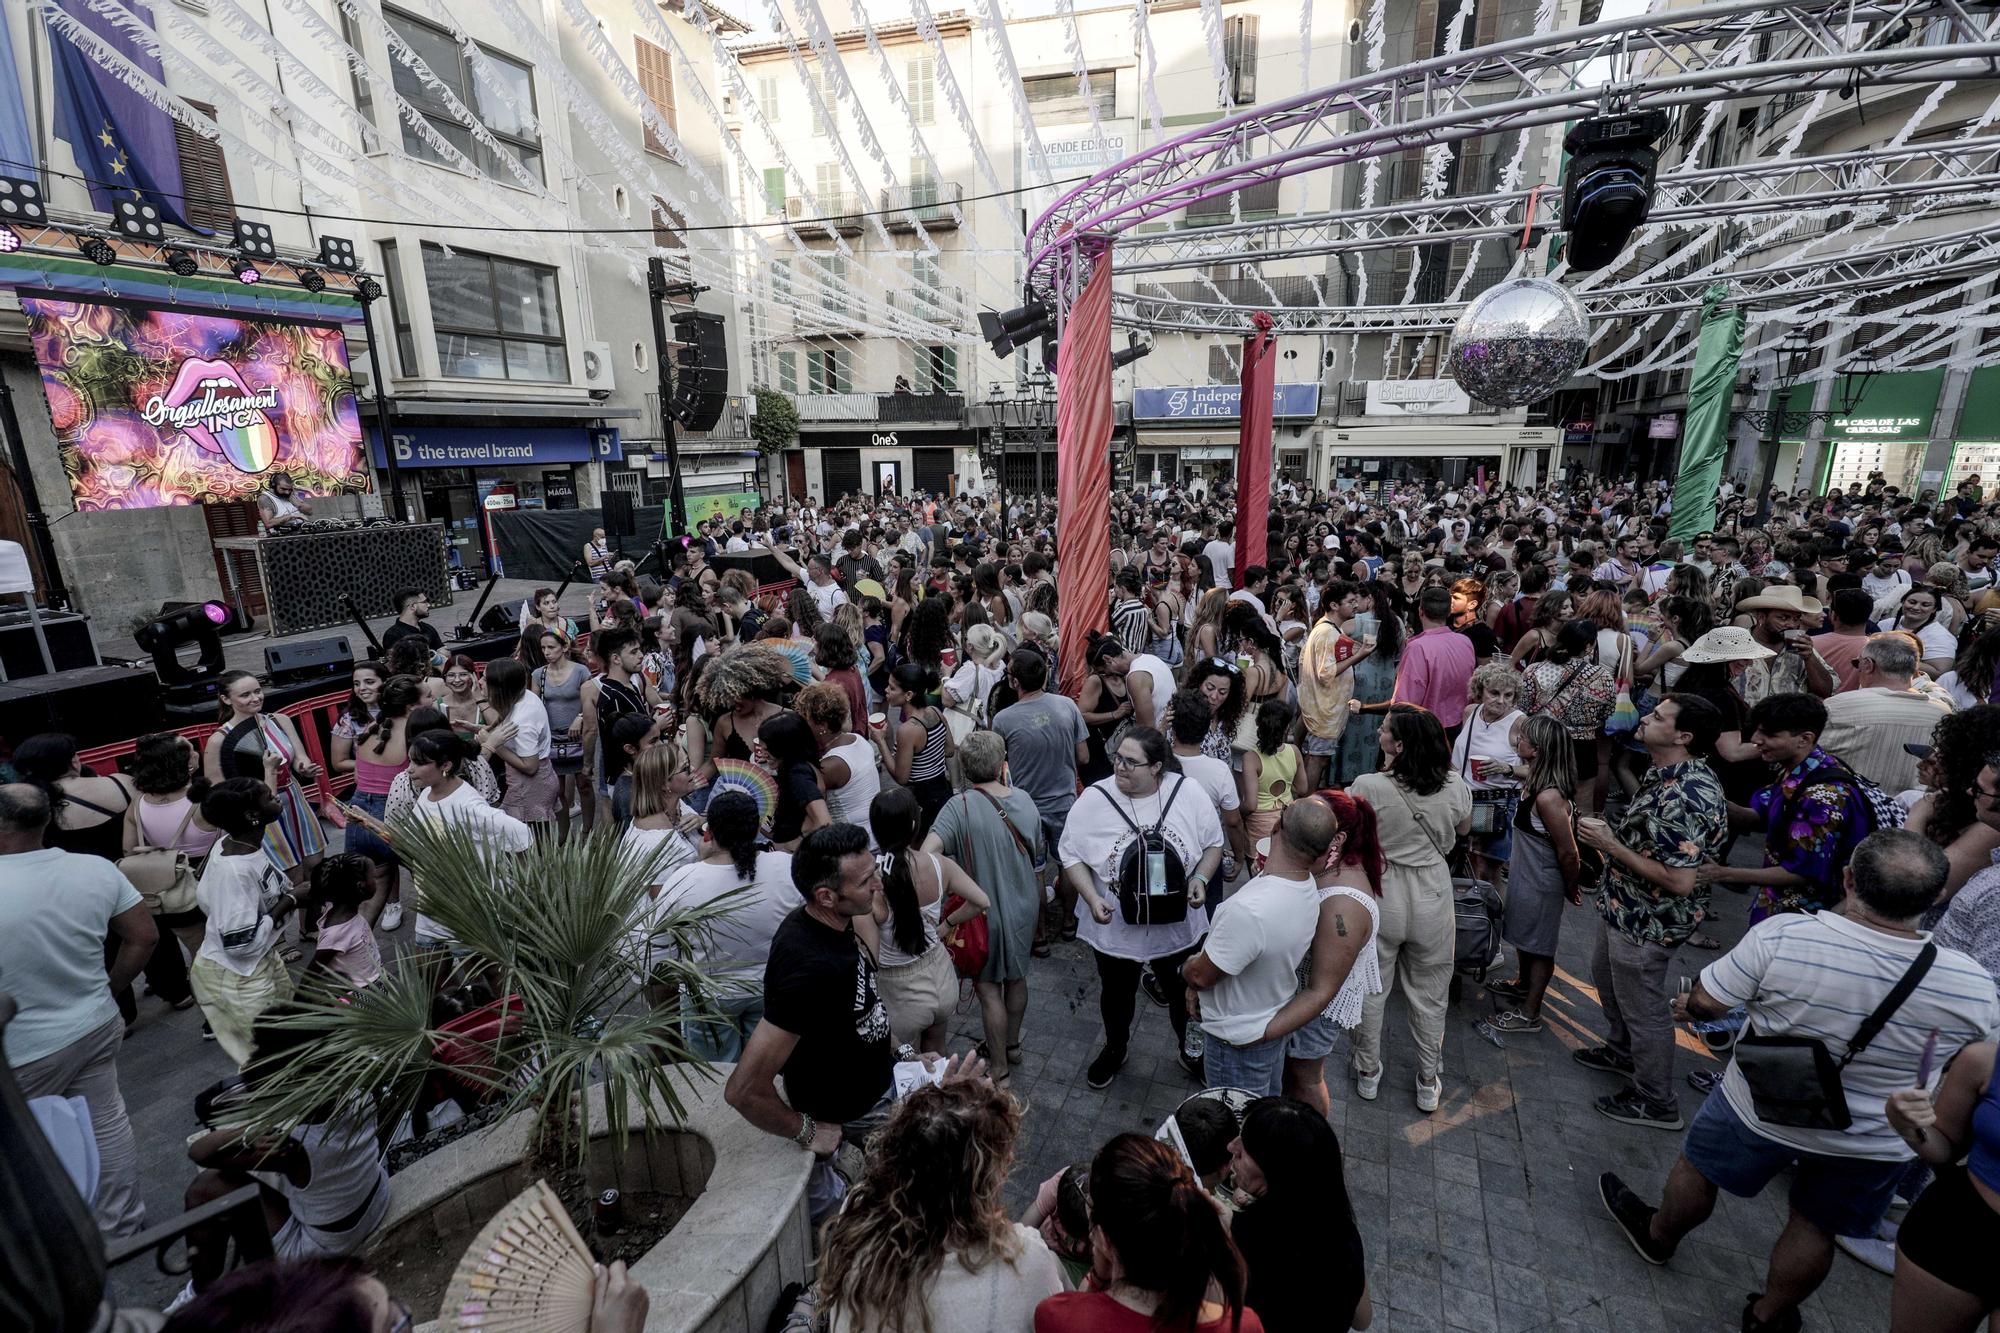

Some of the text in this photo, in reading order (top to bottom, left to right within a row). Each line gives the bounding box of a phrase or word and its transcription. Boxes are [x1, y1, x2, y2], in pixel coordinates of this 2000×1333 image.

[1043, 140, 1079, 154] VENDE
[141, 385, 279, 429] Orgullosament
[1191, 403, 1231, 416] d'Inca
[1405, 402, 1429, 411] NOU
[208, 408, 265, 434] INCA
[1833, 419, 1849, 427] LA
[1878, 418, 1894, 426] DE
[1895, 418, 1920, 426] LAS
[1845, 426, 1901, 434] CARCASAS
[598, 434, 612, 455] B
[418, 444, 445, 460] the
[447, 443, 490, 459] travel
[493, 443, 534, 458] brand
[547, 488, 573, 497] MAGIA
